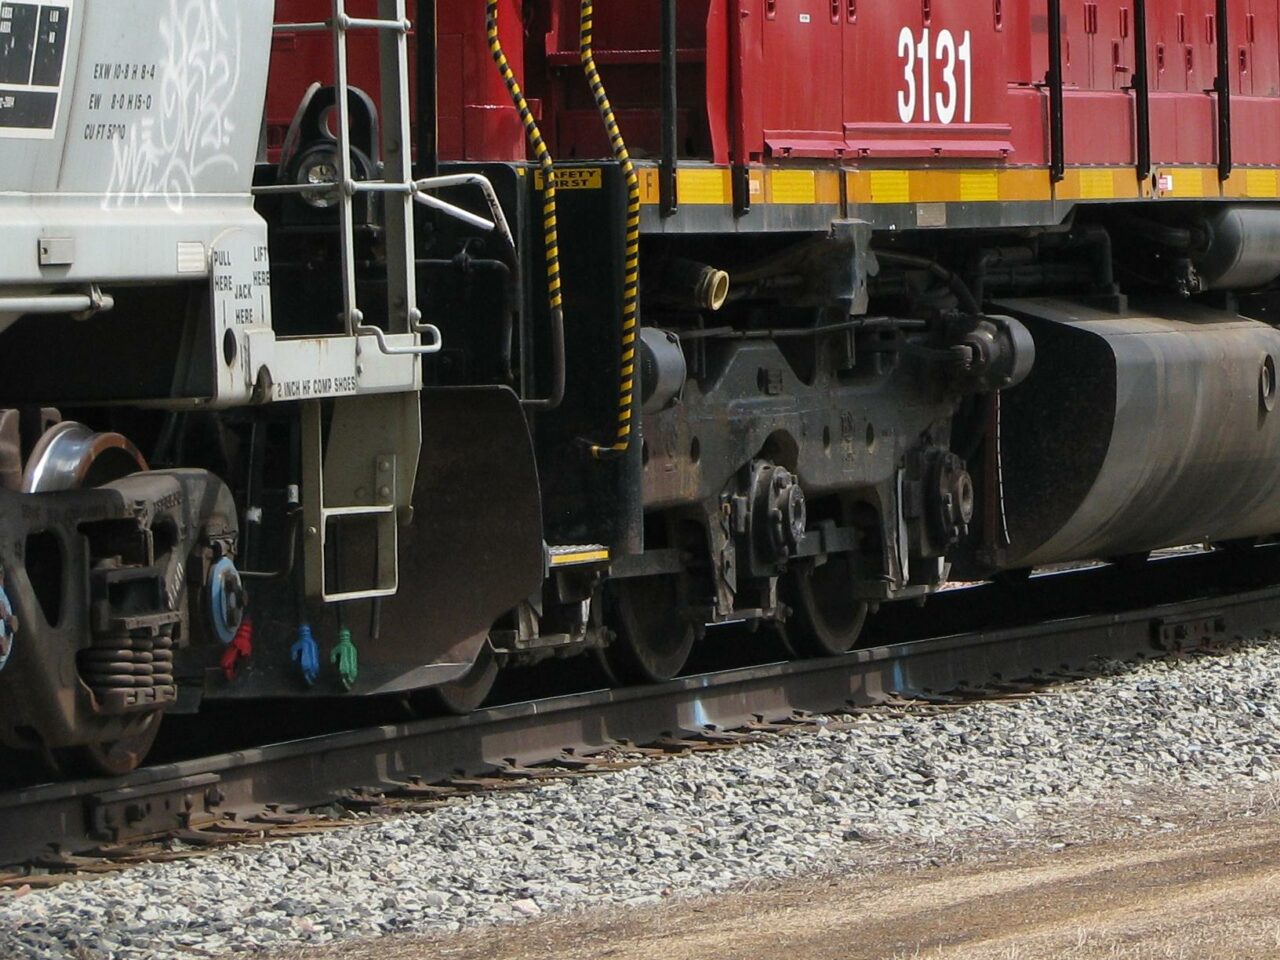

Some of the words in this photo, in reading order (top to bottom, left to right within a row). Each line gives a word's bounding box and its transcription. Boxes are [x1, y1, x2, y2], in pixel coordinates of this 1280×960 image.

[93, 63, 112, 80] EXW
[897, 25, 972, 125] 3131
[88, 93, 102, 110] EW
[646, 172, 653, 199] F
[213, 250, 231, 267] PULL
[253, 246, 267, 262] LIFT
[214, 275, 233, 291] HERE
[252, 270, 270, 287] HERE
[234, 283, 253, 299] JACK
[235, 308, 253, 325] HERE
[283, 380, 300, 398] INCH
[313, 377, 332, 395] COMP
[333, 375, 356, 393] SHOES
